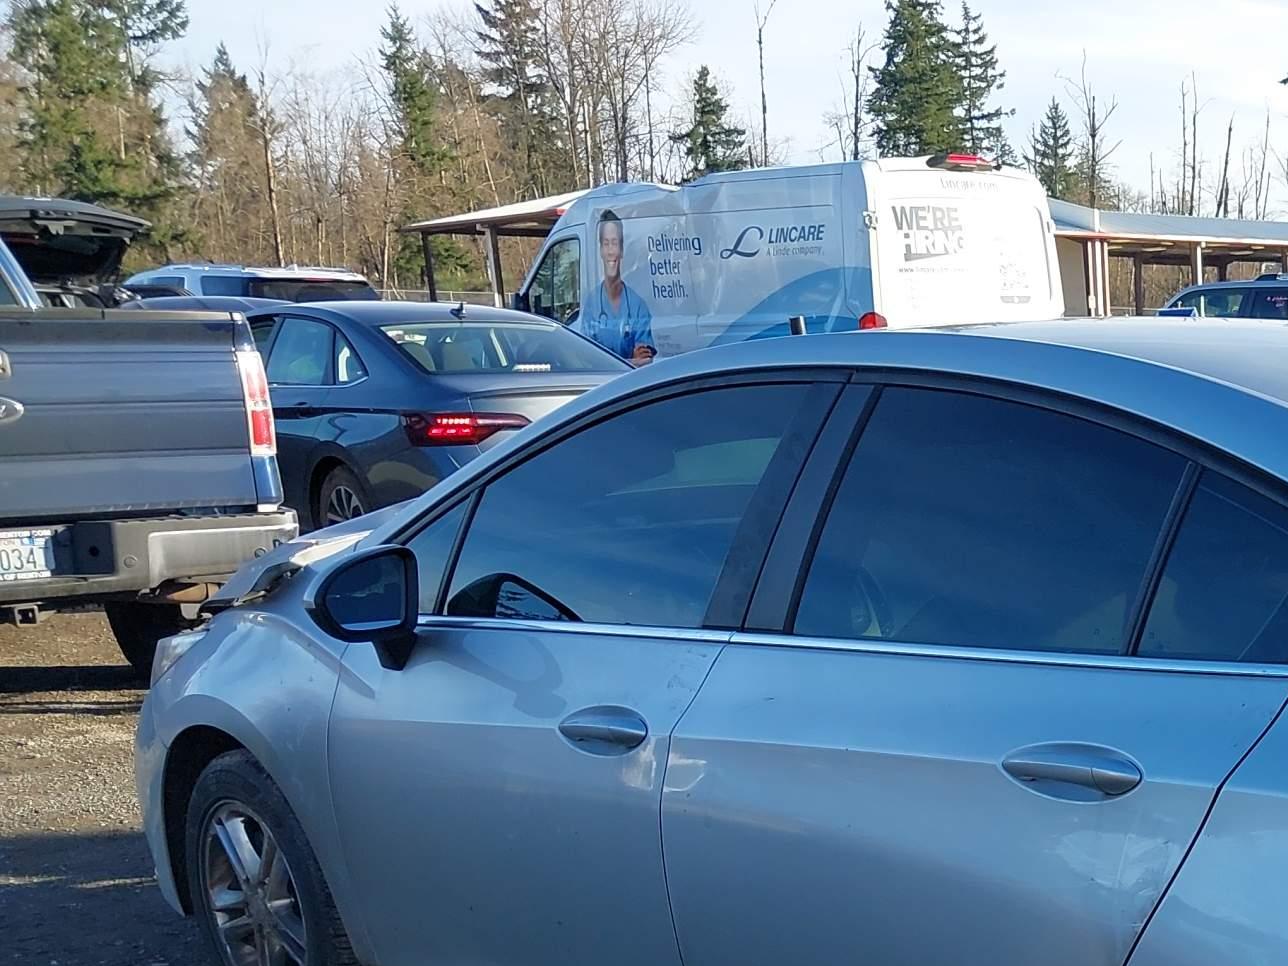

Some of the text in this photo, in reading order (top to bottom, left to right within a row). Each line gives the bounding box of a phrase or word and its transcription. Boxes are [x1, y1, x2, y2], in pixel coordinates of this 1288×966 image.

[891, 205, 962, 231] WE'RE
[648, 233, 702, 255] Delivering
[768, 224, 825, 244] LINCARE
[650, 258, 681, 276] better
[653, 279, 688, 299] health.
